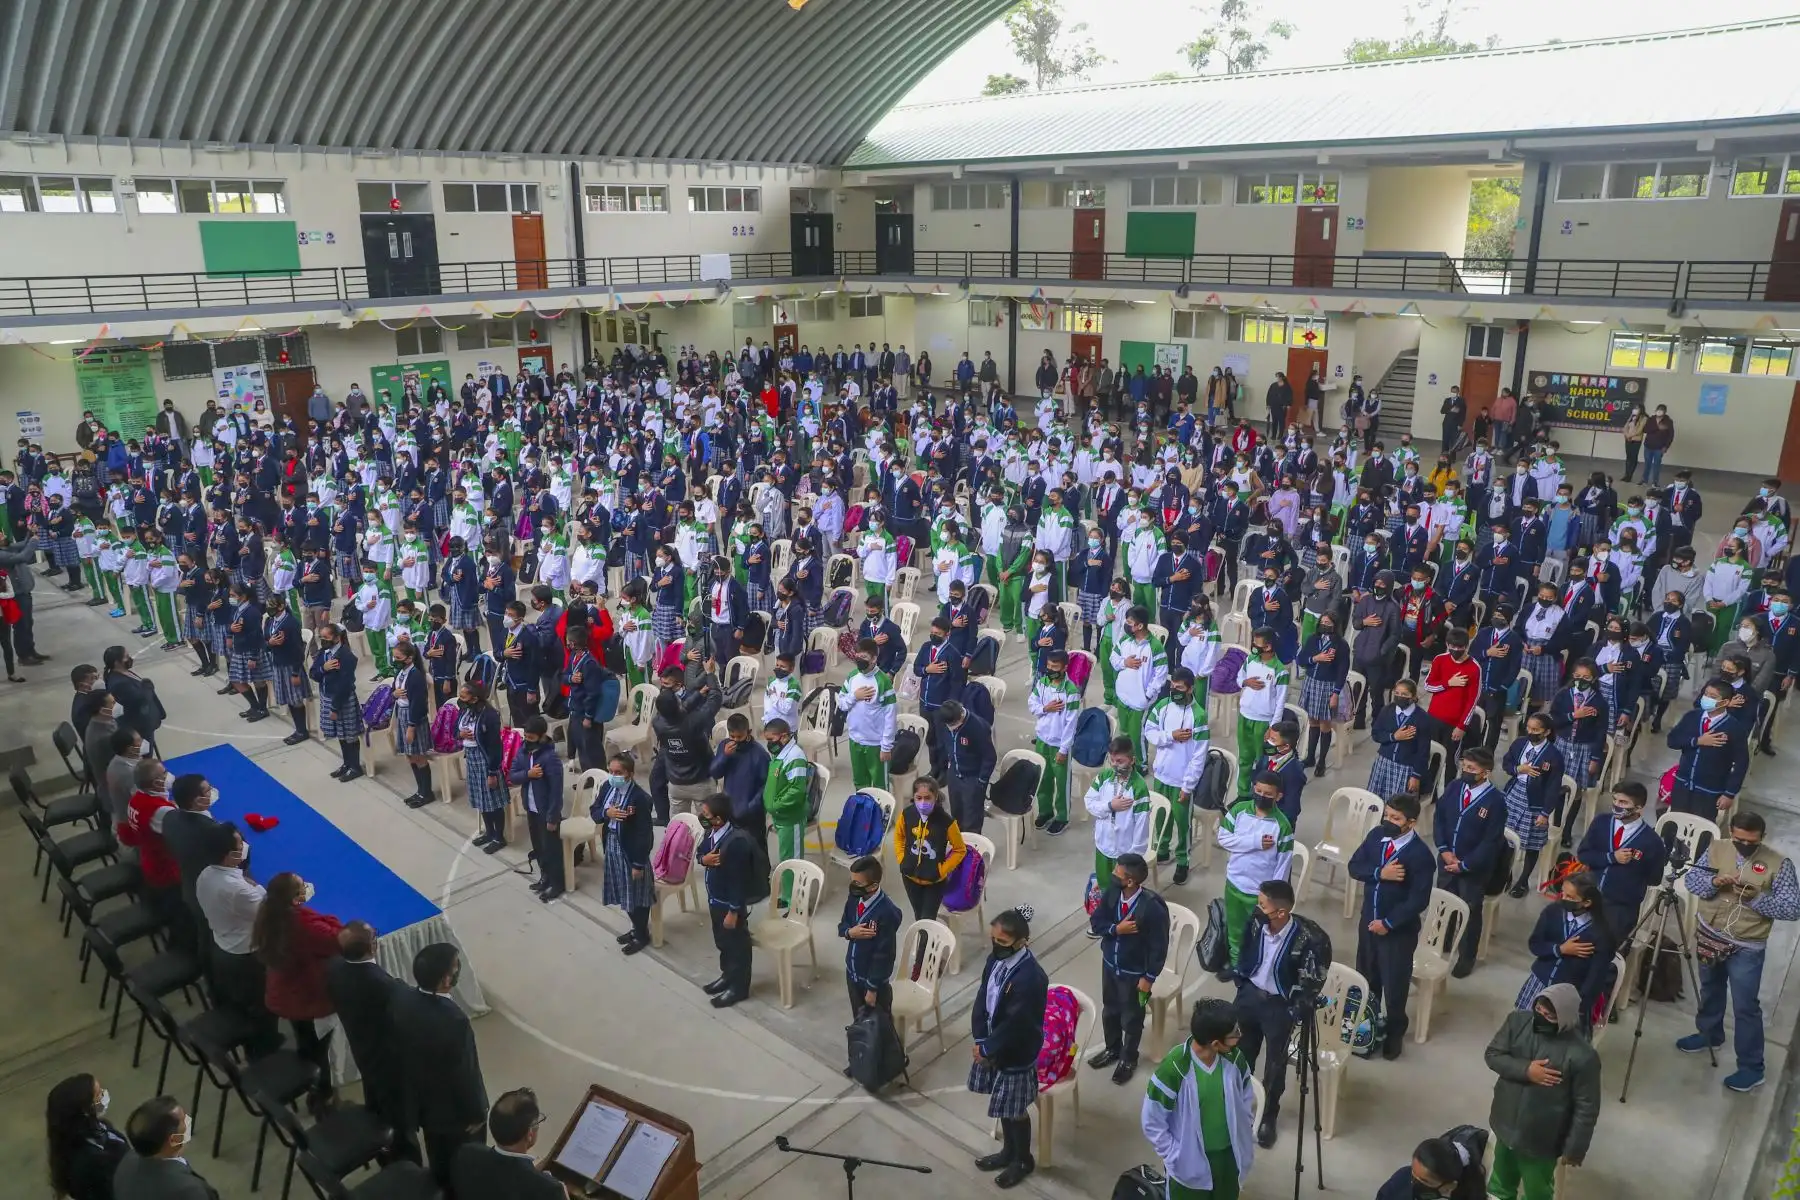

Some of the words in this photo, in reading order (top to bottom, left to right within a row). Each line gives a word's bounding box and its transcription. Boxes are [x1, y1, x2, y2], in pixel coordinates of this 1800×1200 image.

[1569, 387, 1607, 398] HAPPY
[1584, 398, 1609, 409] DAY
[1613, 399, 1630, 411] OF
